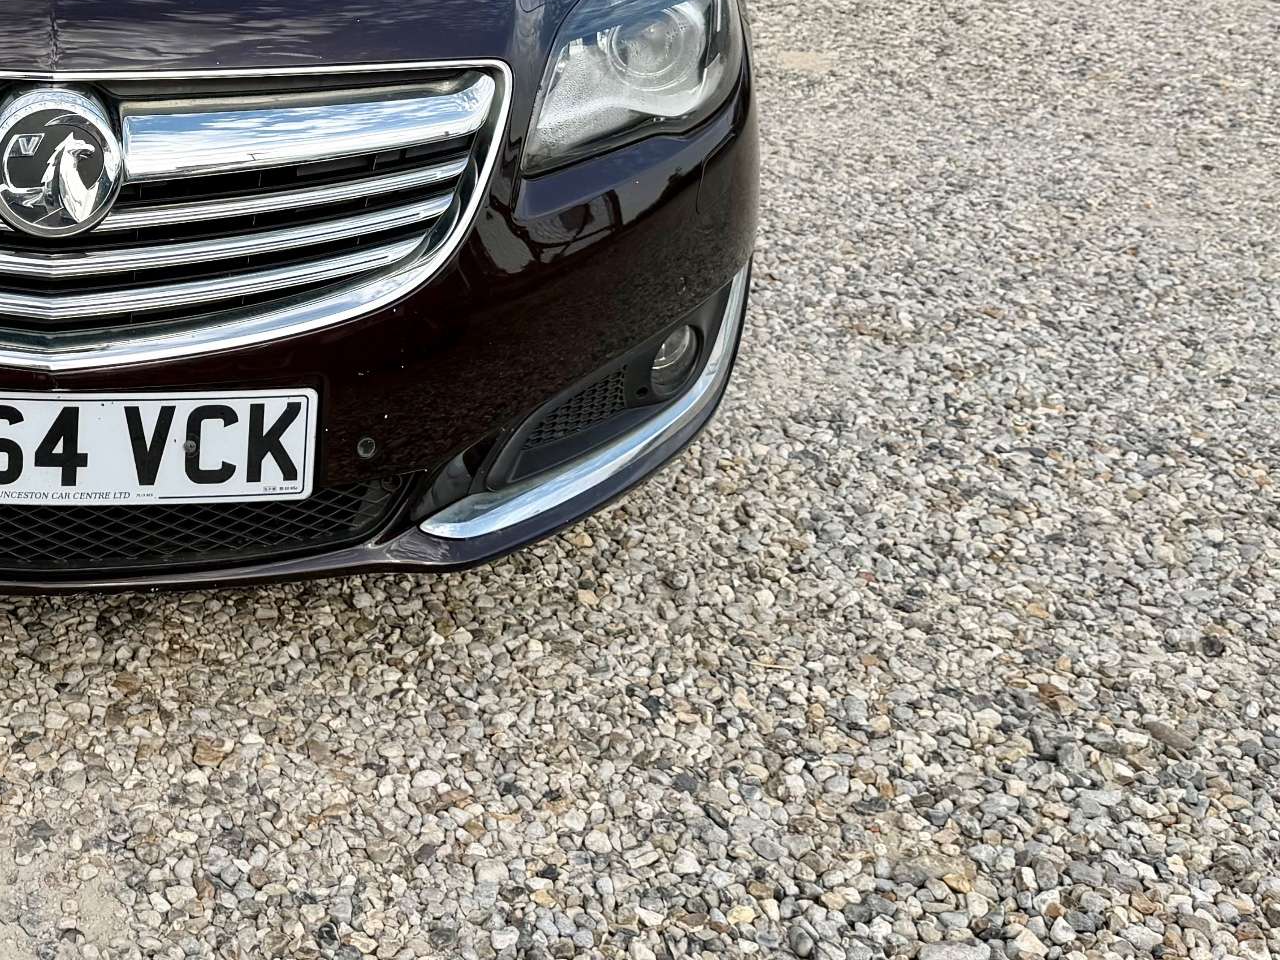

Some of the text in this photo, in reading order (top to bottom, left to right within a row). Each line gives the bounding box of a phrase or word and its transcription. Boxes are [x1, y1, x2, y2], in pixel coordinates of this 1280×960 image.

[124, 401, 302, 486] VCK
[51, 490, 71, 500] CAR
[72, 490, 111, 500] CENTRE
[112, 490, 131, 499] LTD
